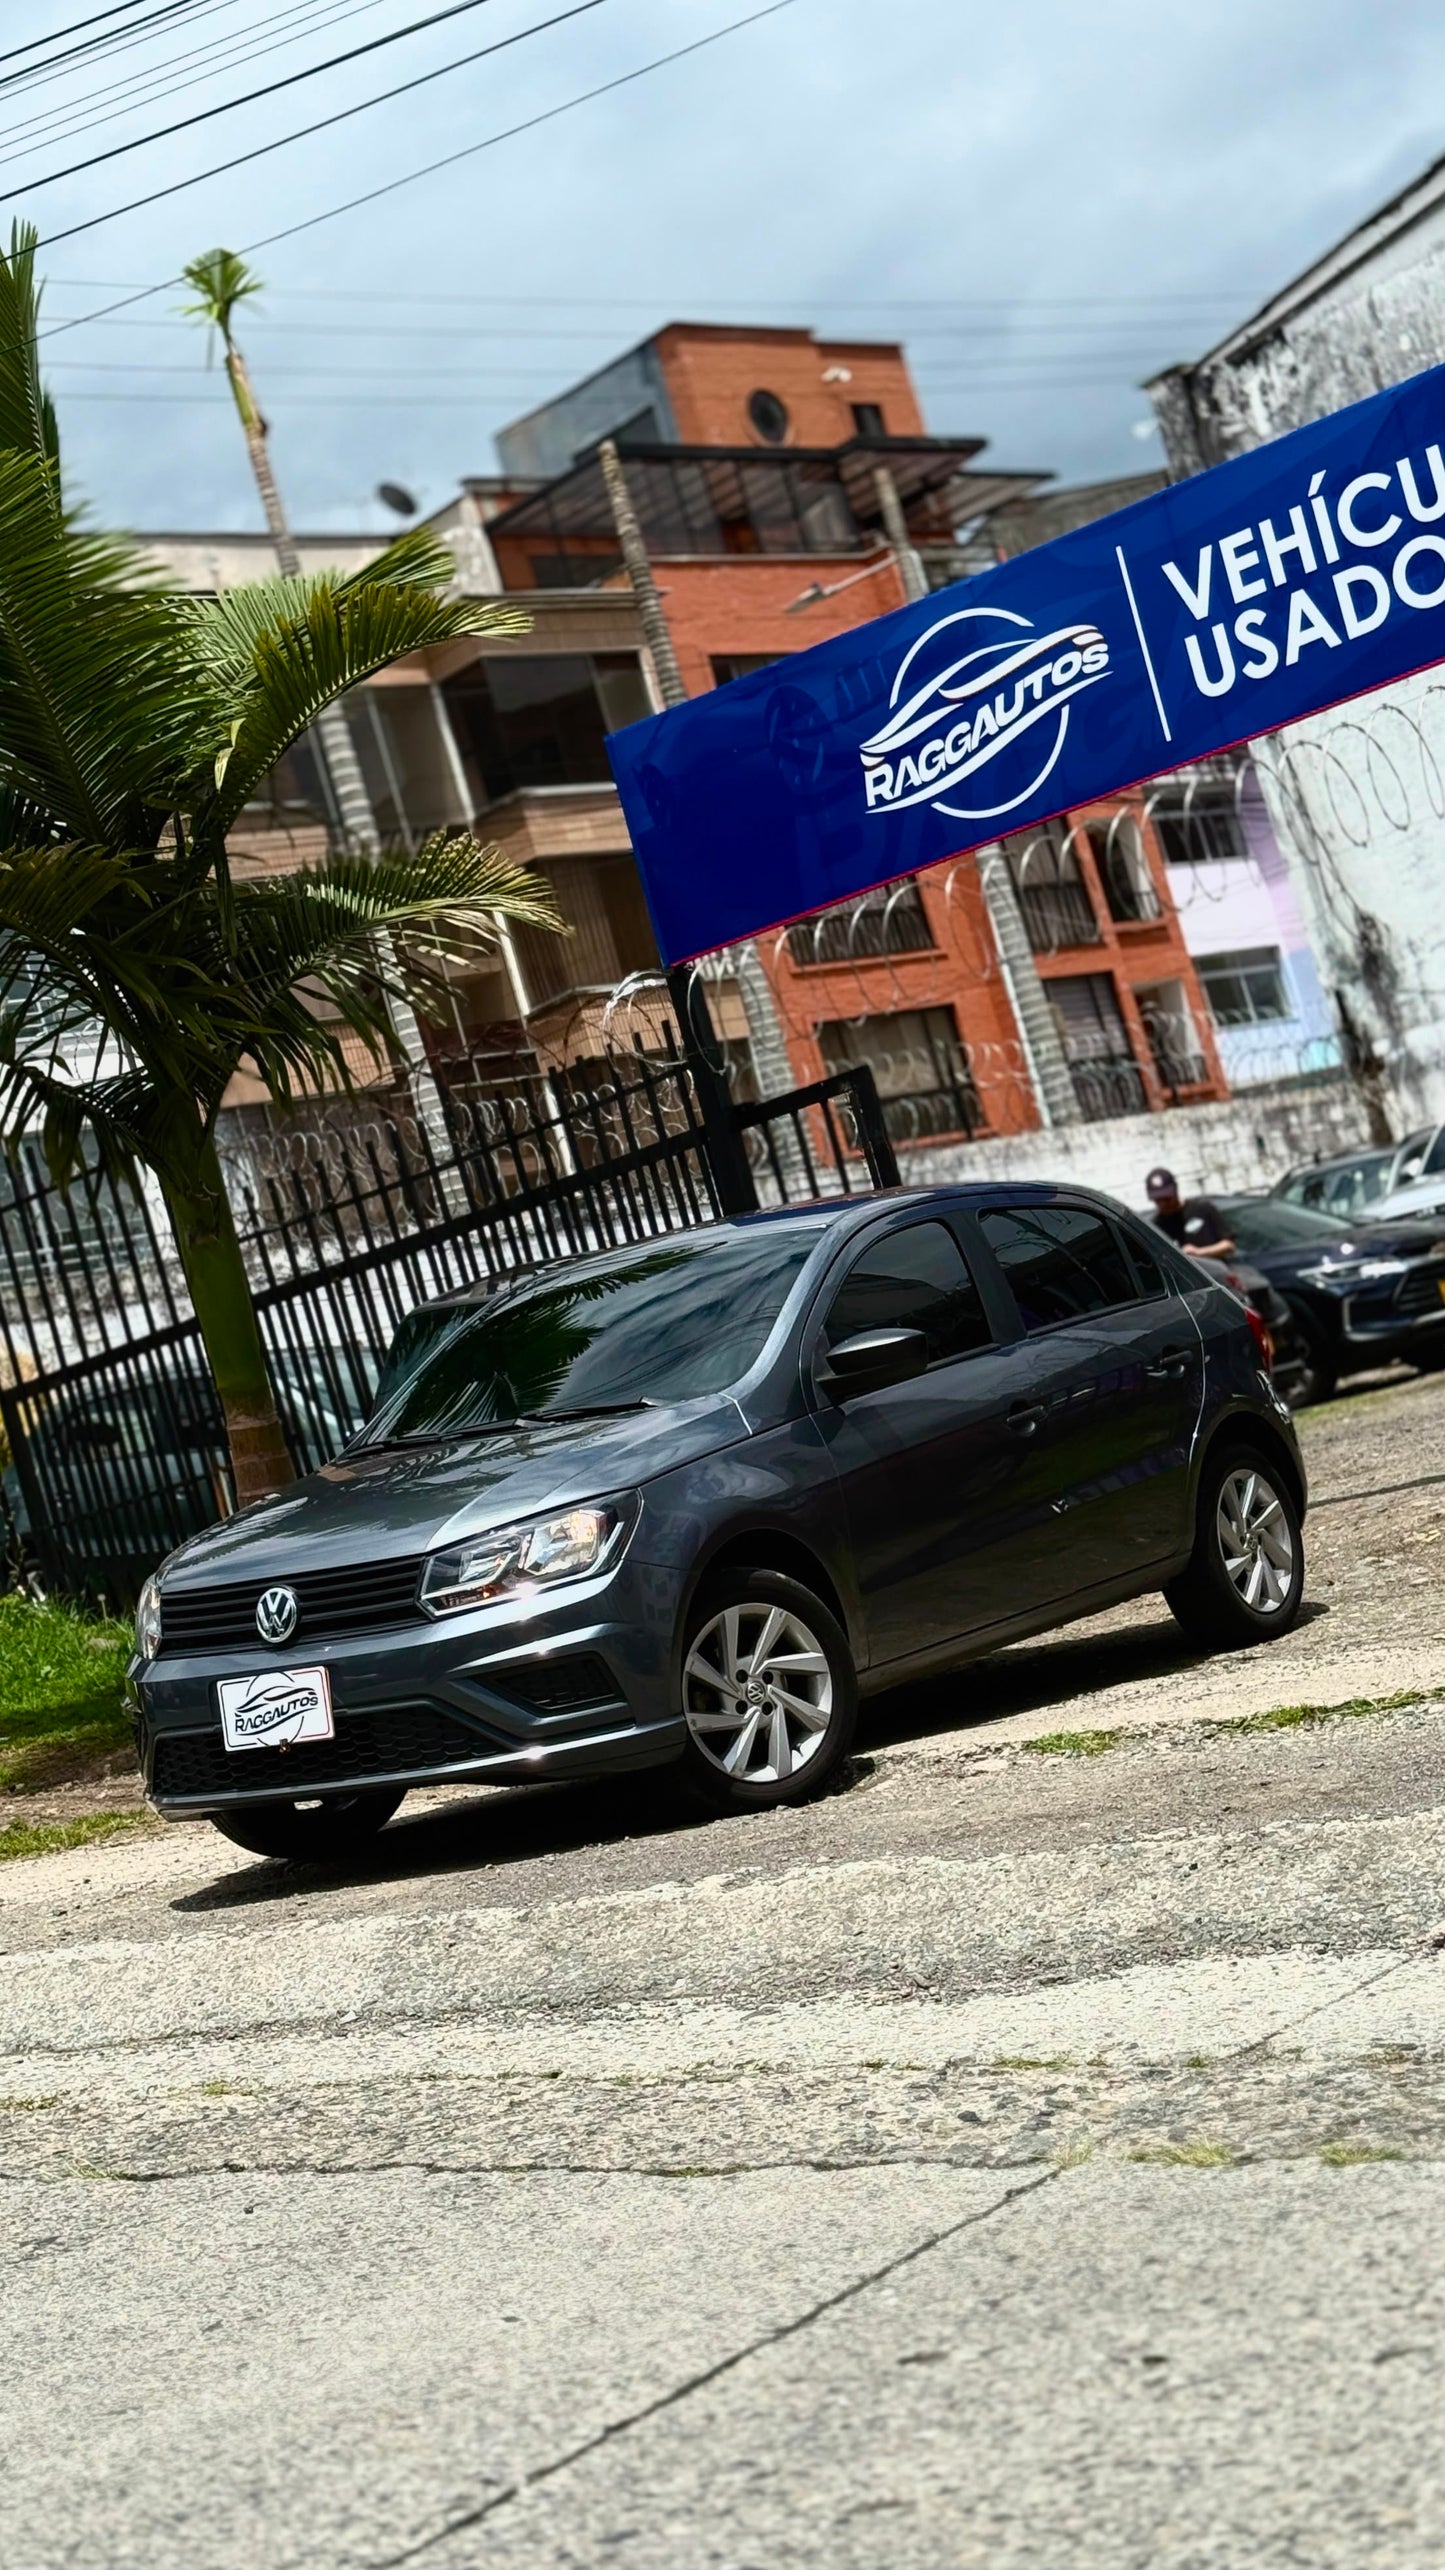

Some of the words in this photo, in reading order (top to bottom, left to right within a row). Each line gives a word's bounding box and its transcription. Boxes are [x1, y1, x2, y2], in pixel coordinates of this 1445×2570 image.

[1161, 443, 1445, 621] VEHÍCU
[1184, 534, 1445, 698] USADO
[864, 642, 1110, 808] RAGGAUTOS
[234, 1696, 319, 1733] RAGGAUTOS
